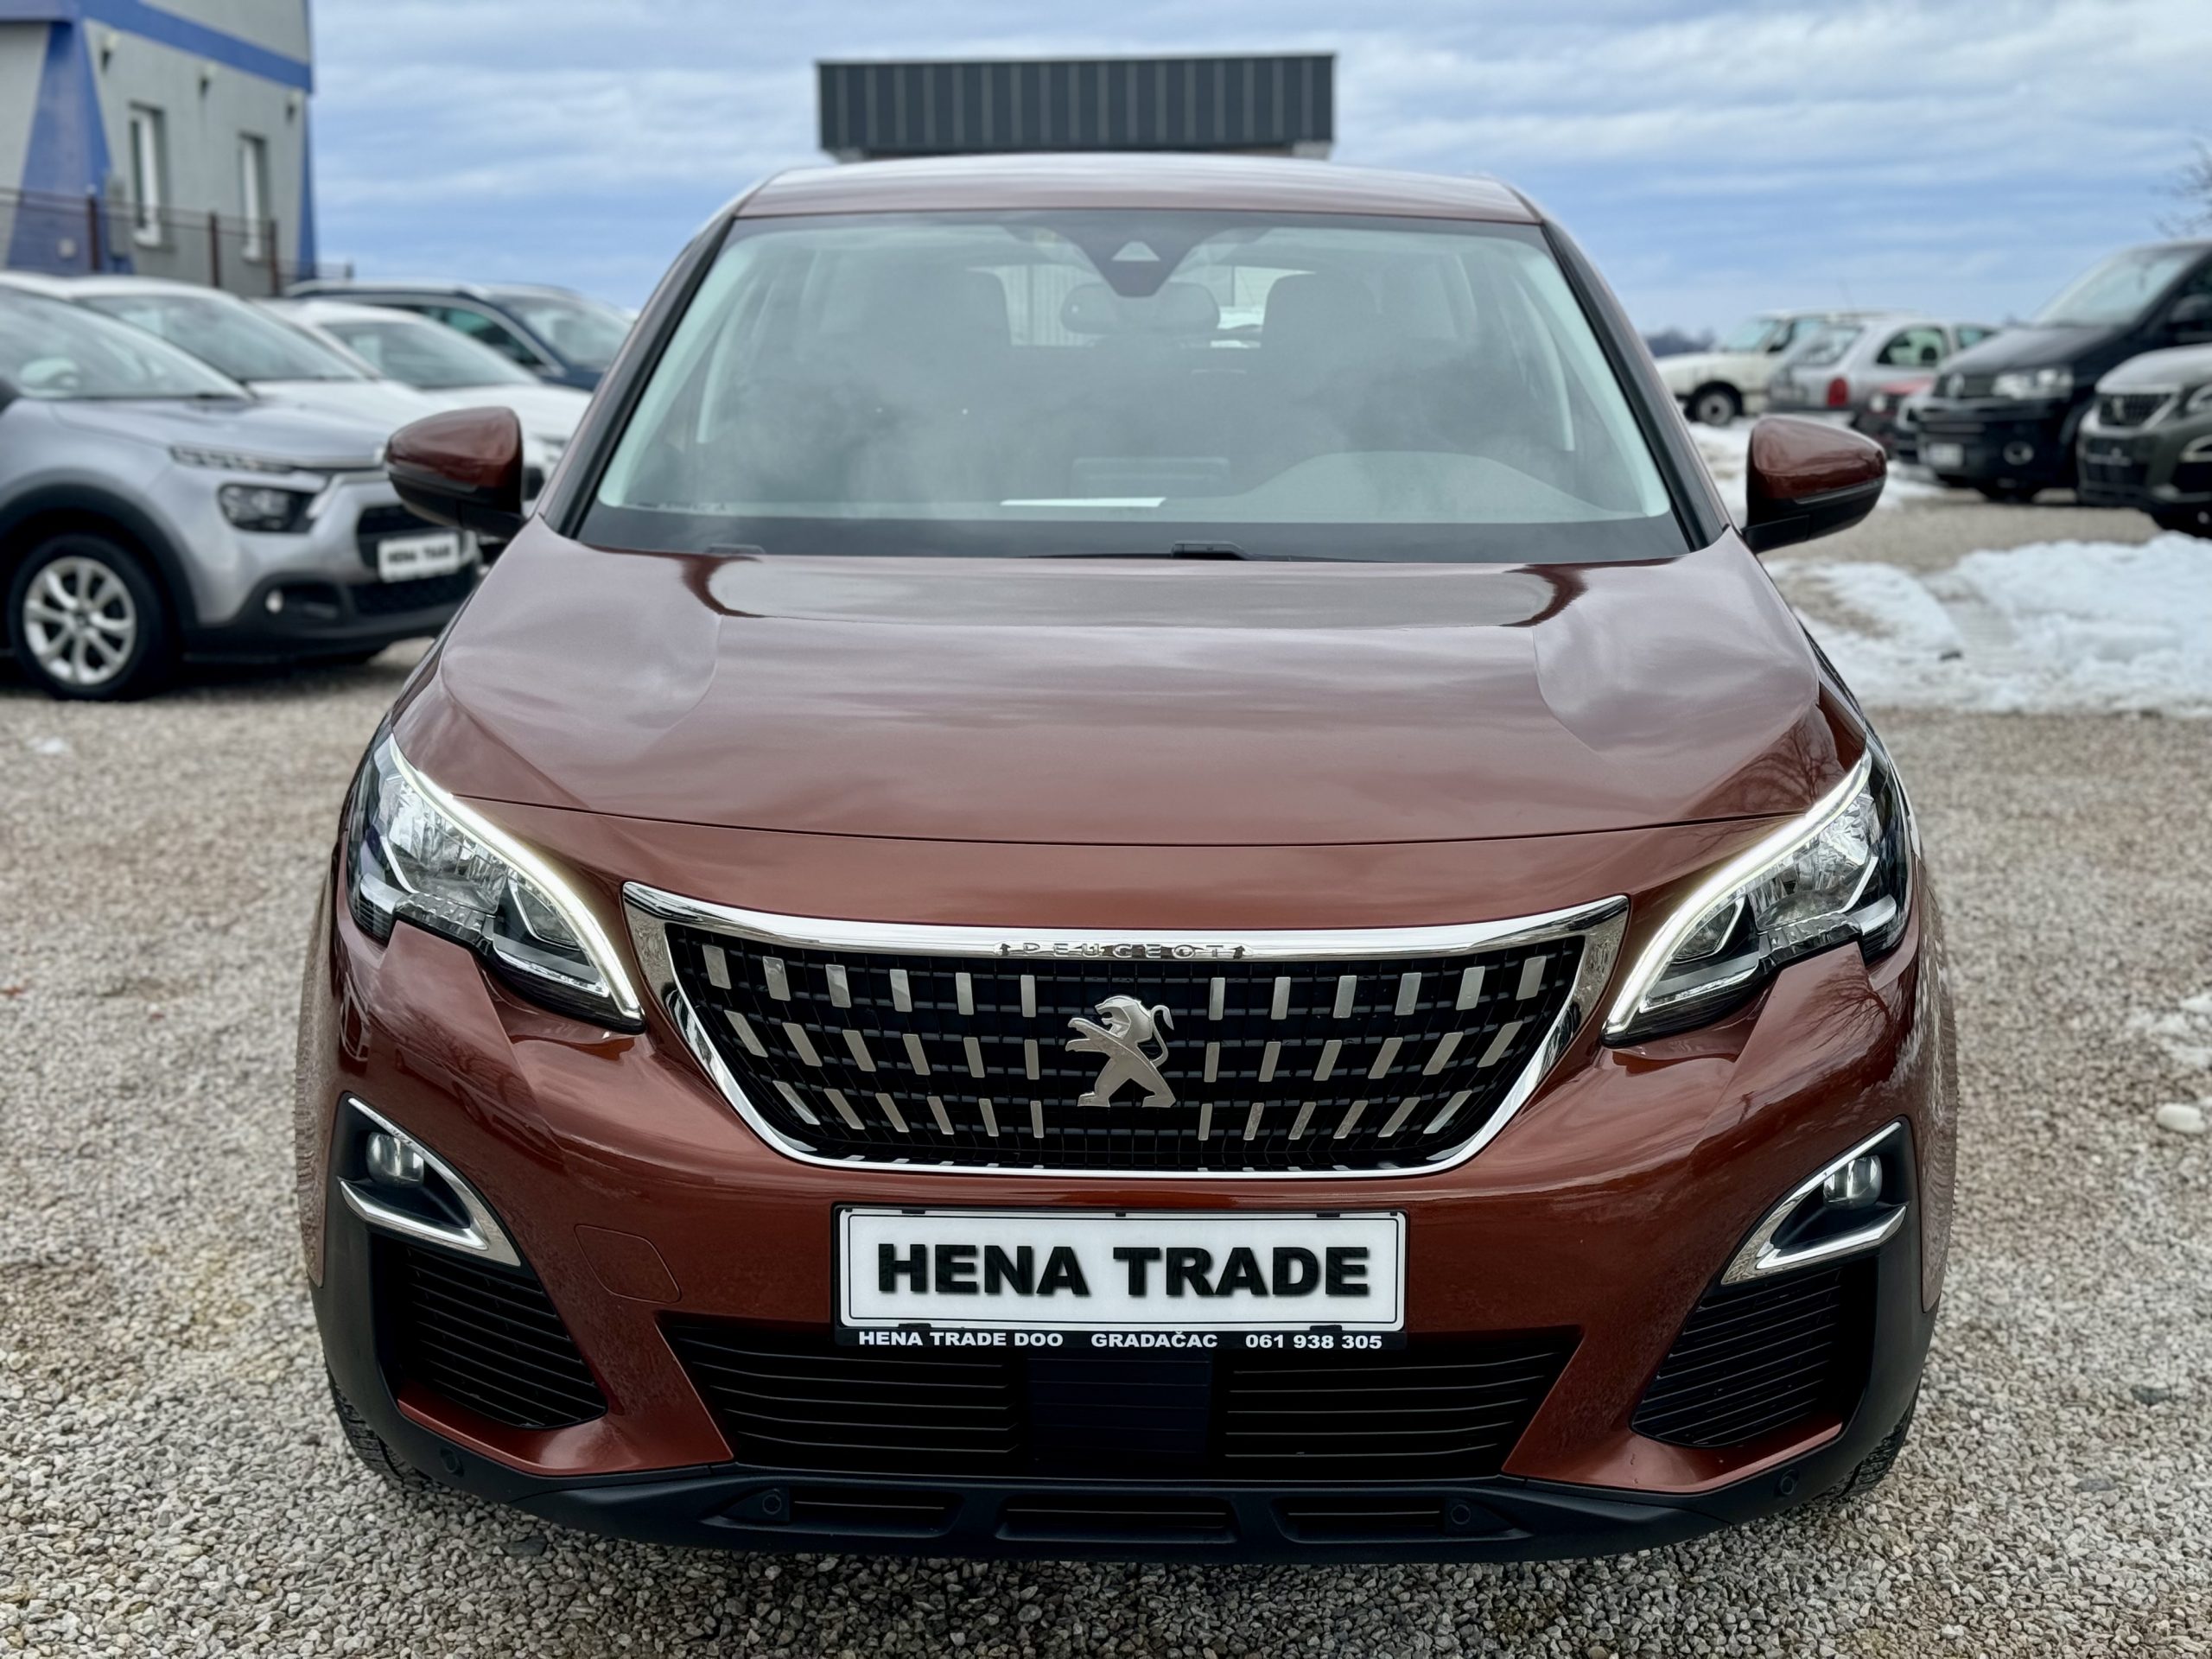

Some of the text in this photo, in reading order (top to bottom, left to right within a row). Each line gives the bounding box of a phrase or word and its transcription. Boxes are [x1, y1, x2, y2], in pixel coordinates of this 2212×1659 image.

[1022, 943, 1224, 959] PEUGEOT
[878, 1243, 1370, 1298] HENA TRADE
[859, 1331, 1382, 1350] HENA TRADE DOO GRADAČAC 061 938 305
